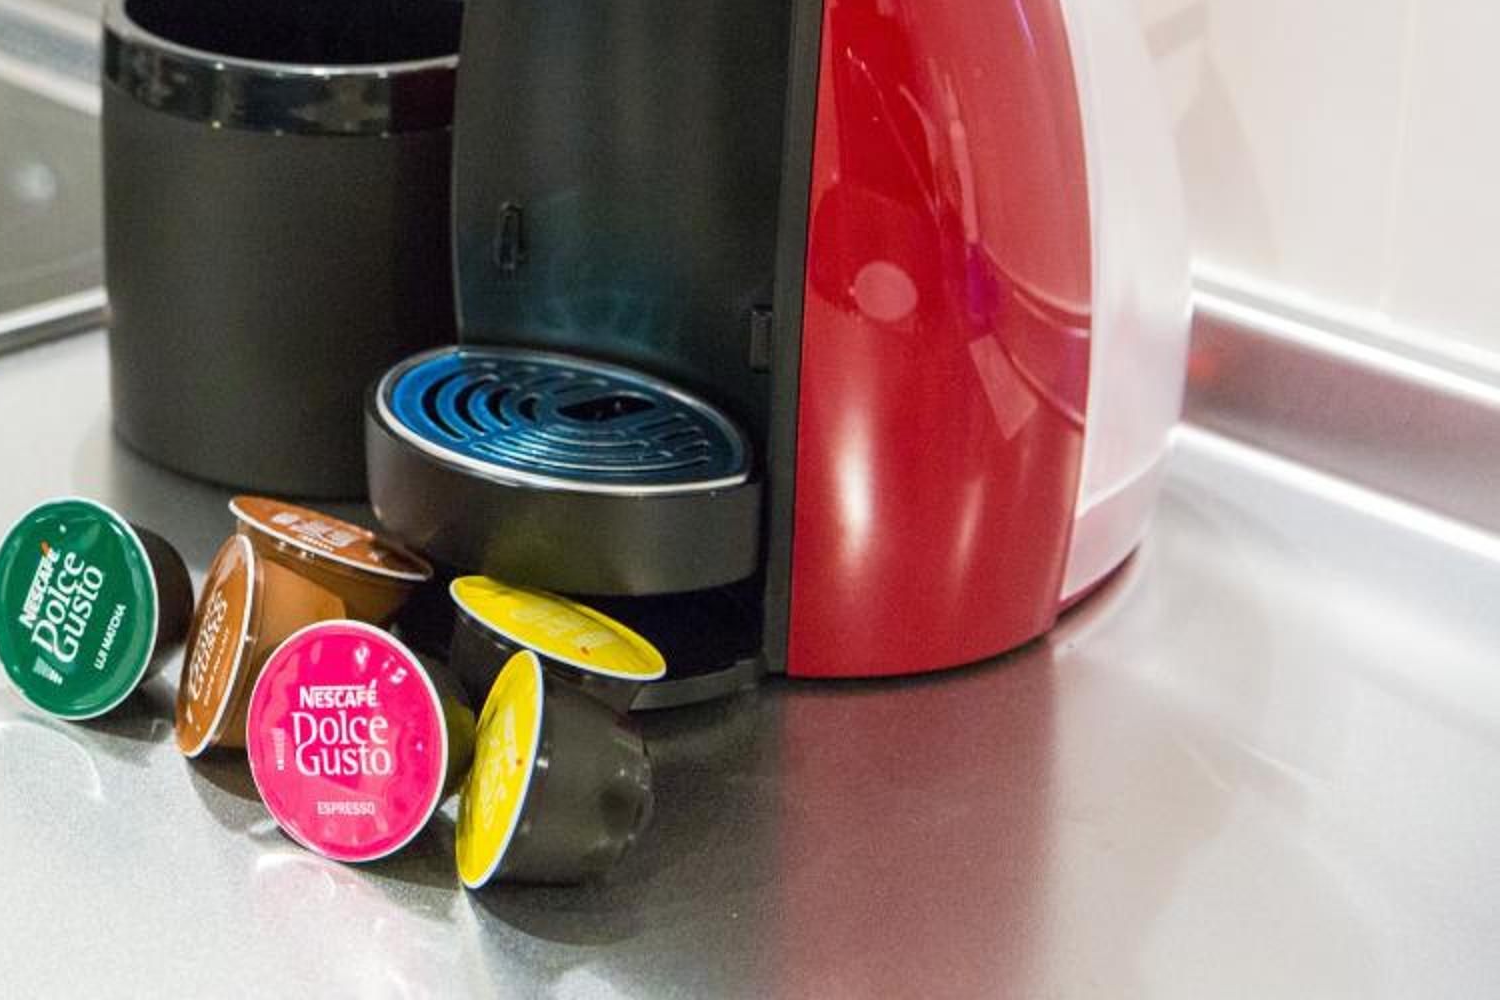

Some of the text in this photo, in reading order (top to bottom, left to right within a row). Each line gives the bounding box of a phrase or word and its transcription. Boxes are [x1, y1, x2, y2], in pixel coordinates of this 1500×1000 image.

[32, 552, 86, 653] Dolce
[50, 566, 104, 663] Gusto
[103, 604, 127, 652] MATCHA
[299, 679, 378, 708] NESCAFÉ
[291, 711, 388, 745] Dolce
[295, 743, 391, 777] Gusto
[317, 802, 375, 815] ESPRESSO
